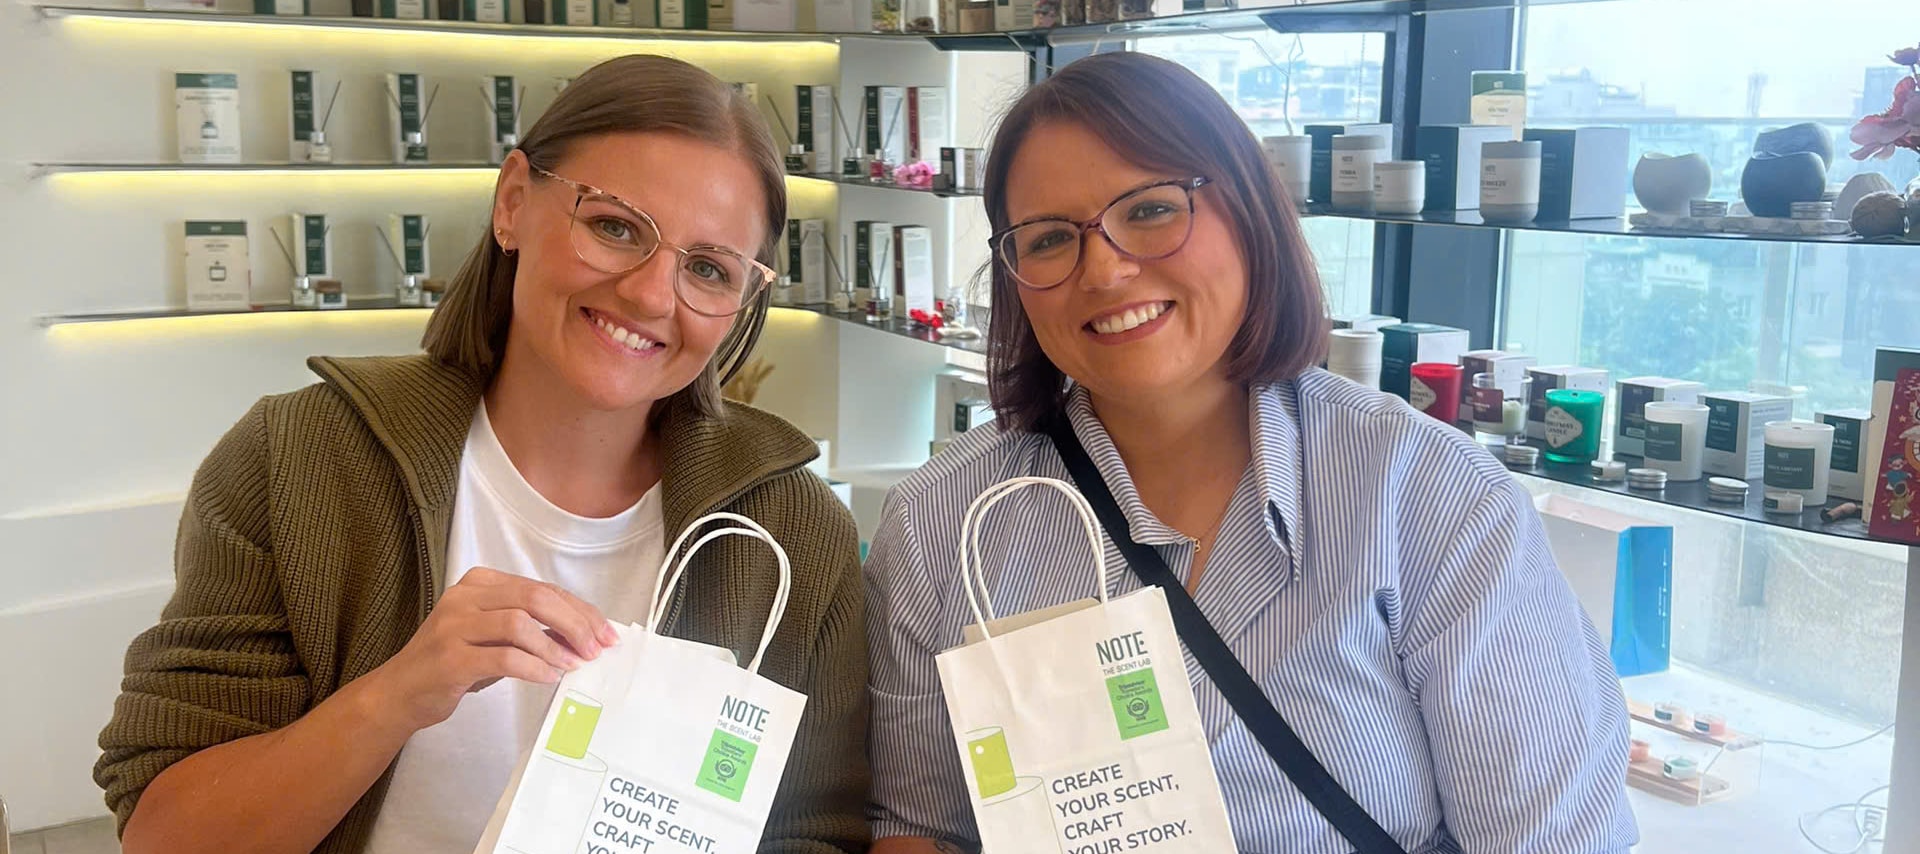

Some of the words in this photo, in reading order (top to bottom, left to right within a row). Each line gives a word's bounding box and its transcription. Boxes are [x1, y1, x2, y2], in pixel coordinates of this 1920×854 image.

[1096, 631, 1148, 665] NOTE
[1103, 667, 1115, 676] THE
[1116, 661, 1137, 673] SCENT
[1138, 658, 1151, 668] LAB
[720, 695, 770, 732] NOTE
[717, 719, 728, 729] THE
[730, 723, 749, 737] SCENT
[749, 732, 762, 743] LAB
[1052, 764, 1123, 794] CREATE
[610, 777, 680, 815] CREATE
[1056, 792, 1110, 818] YOUR
[1113, 774, 1180, 803] SCENT,
[603, 797, 652, 830] YOUR
[1064, 811, 1124, 840] CRAFT
[593, 821, 655, 854] CRAFT
[1126, 819, 1192, 849] STORY.
